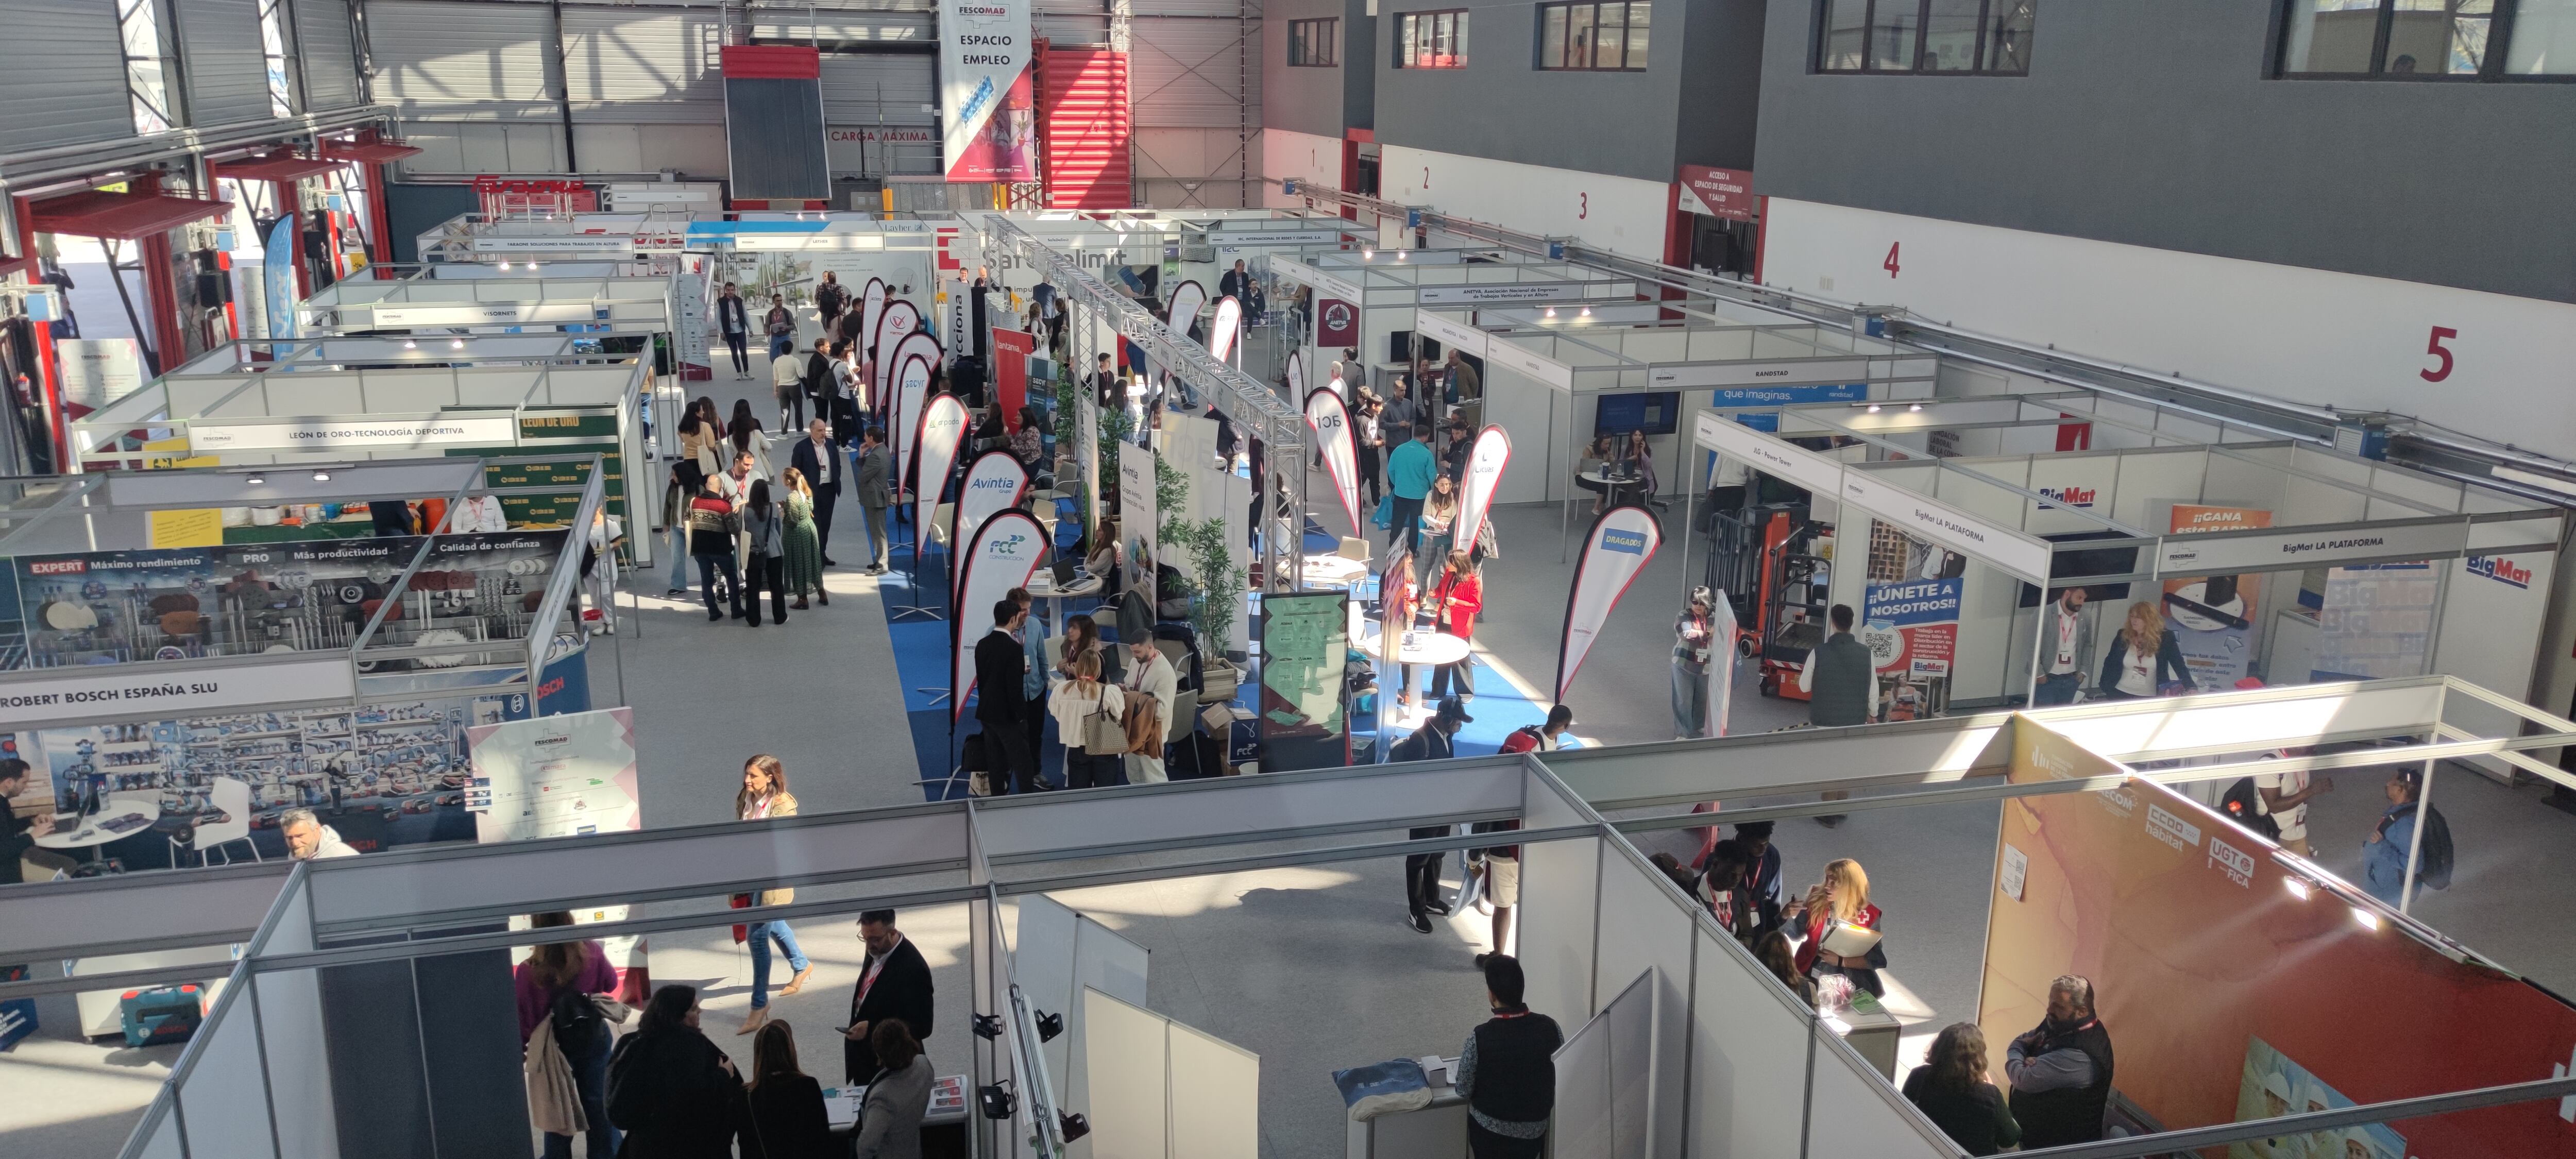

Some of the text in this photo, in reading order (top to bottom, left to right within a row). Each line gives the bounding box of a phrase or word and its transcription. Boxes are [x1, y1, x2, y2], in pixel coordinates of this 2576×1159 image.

[961, 36, 1011, 45] ESPACIO
[963, 55, 1010, 65] EMPLEO
[831, 131, 874, 142] CARGA
[1312, 148, 1315, 167] 1
[1423, 166, 1429, 190] 2
[1709, 171, 1725, 180] ACCESO
[462, 175, 585, 193] Faraone
[1695, 180, 1712, 189] ESPACIO
[1718, 184, 1742, 193] SEGURIDAD
[1712, 194, 1726, 202] SALUD
[1579, 192, 1587, 220] 3
[1884, 242, 1900, 279] 4
[997, 340, 1019, 352] lantania
[2420, 326, 2458, 383] 5
[905, 380, 925, 388] sacyr
[1032, 377, 1046, 386] sacyr
[1724, 388, 1792, 402] que imaginas.
[938, 418, 959, 427] arpada
[290, 429, 314, 438] LEÓN
[331, 427, 412, 437] ORO-TECNOLOGÍA
[415, 427, 464, 436] DEPORTIVA
[1929, 445, 1936, 453] DE
[1930, 437, 1952, 449] LABORAL
[1764, 451, 1778, 462] Power
[1778, 457, 1792, 467] Tower
[1123, 464, 1138, 480] Avintia
[971, 478, 1014, 489] Avintia
[1848, 484, 1863, 494] FESCOMAD
[2040, 487, 2096, 507] BigMat
[2193, 512, 2242, 523] ¡¡GANA
[1914, 509, 1985, 543] BigMat LA PLATAFORMA
[440, 542, 476, 552] Calidad
[494, 540, 539, 549] confianza
[990, 540, 1018, 554] FCC
[1606, 535, 1642, 547] DRAGADOS
[2283, 537, 2384, 553] BigMat LA PLATAFORMA
[243, 554, 269, 564] PRO
[294, 547, 388, 559] Más productividad
[31, 561, 83, 574] EXPERT
[91, 557, 201, 570] Máximo rendimiento
[2467, 556, 2532, 585] BigMat
[1869, 583, 1953, 604] ¡¡ÚNETE A
[1871, 599, 1956, 617] NOSOTROS!!
[1914, 661, 1944, 670] BigMat
[537, 676, 564, 700] OSCH
[0, 683, 218, 708] ROBERT BOSCH ESPAÑA SLU
[535, 737, 567, 745] FESCOMAD
[1237, 747, 1252, 756] FCC
[2151, 808, 2184, 833] CCOO
[2145, 821, 2184, 853] hábitat
[2212, 841, 2239, 865] UGT
[2227, 868, 2249, 889] FICA
